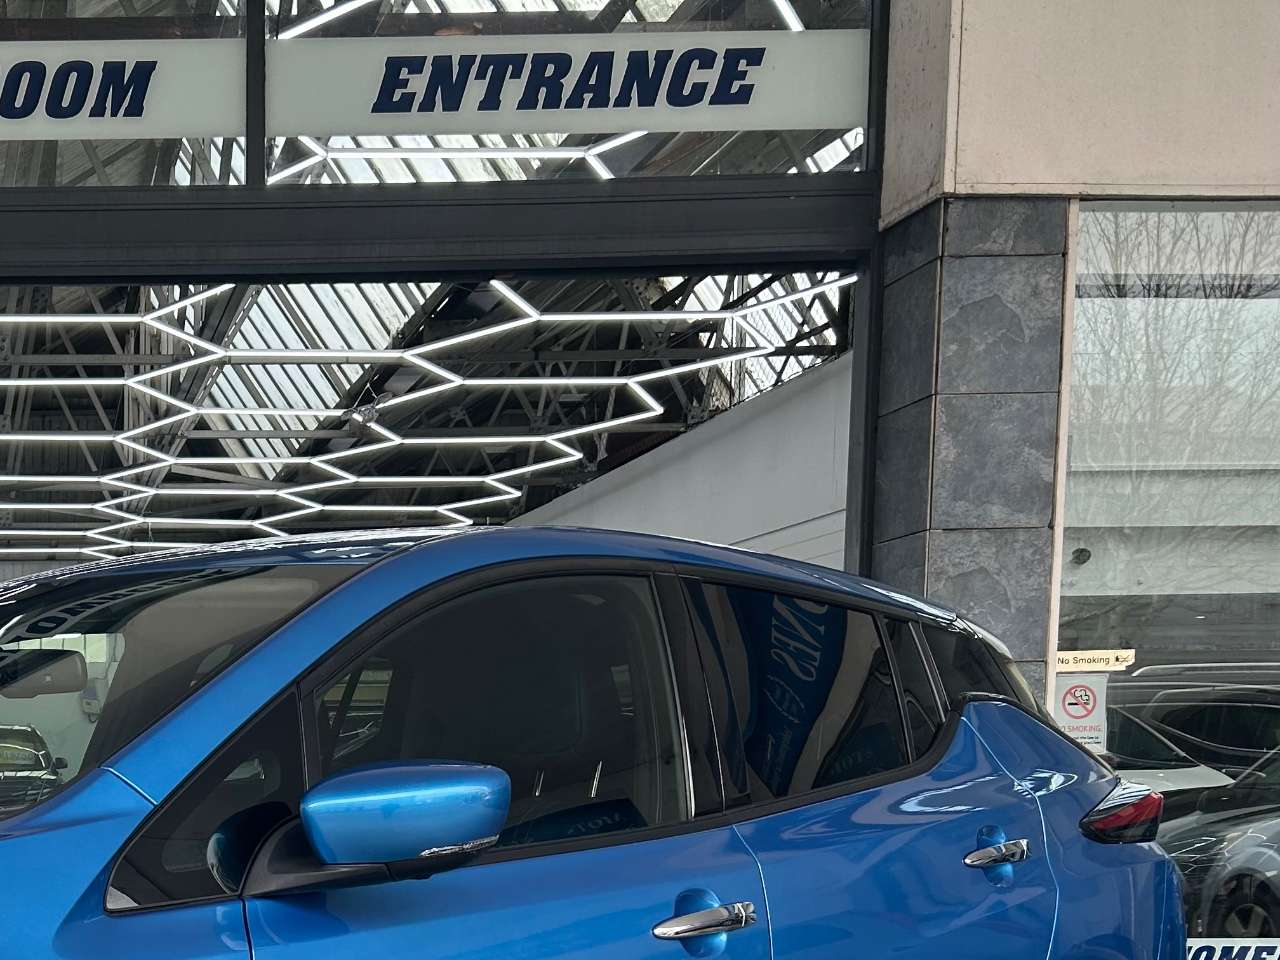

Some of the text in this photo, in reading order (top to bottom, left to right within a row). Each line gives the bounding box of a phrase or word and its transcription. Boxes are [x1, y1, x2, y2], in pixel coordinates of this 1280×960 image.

[370, 47, 767, 114] ENTRANCE
[1057, 656, 1110, 666] No Smoking
